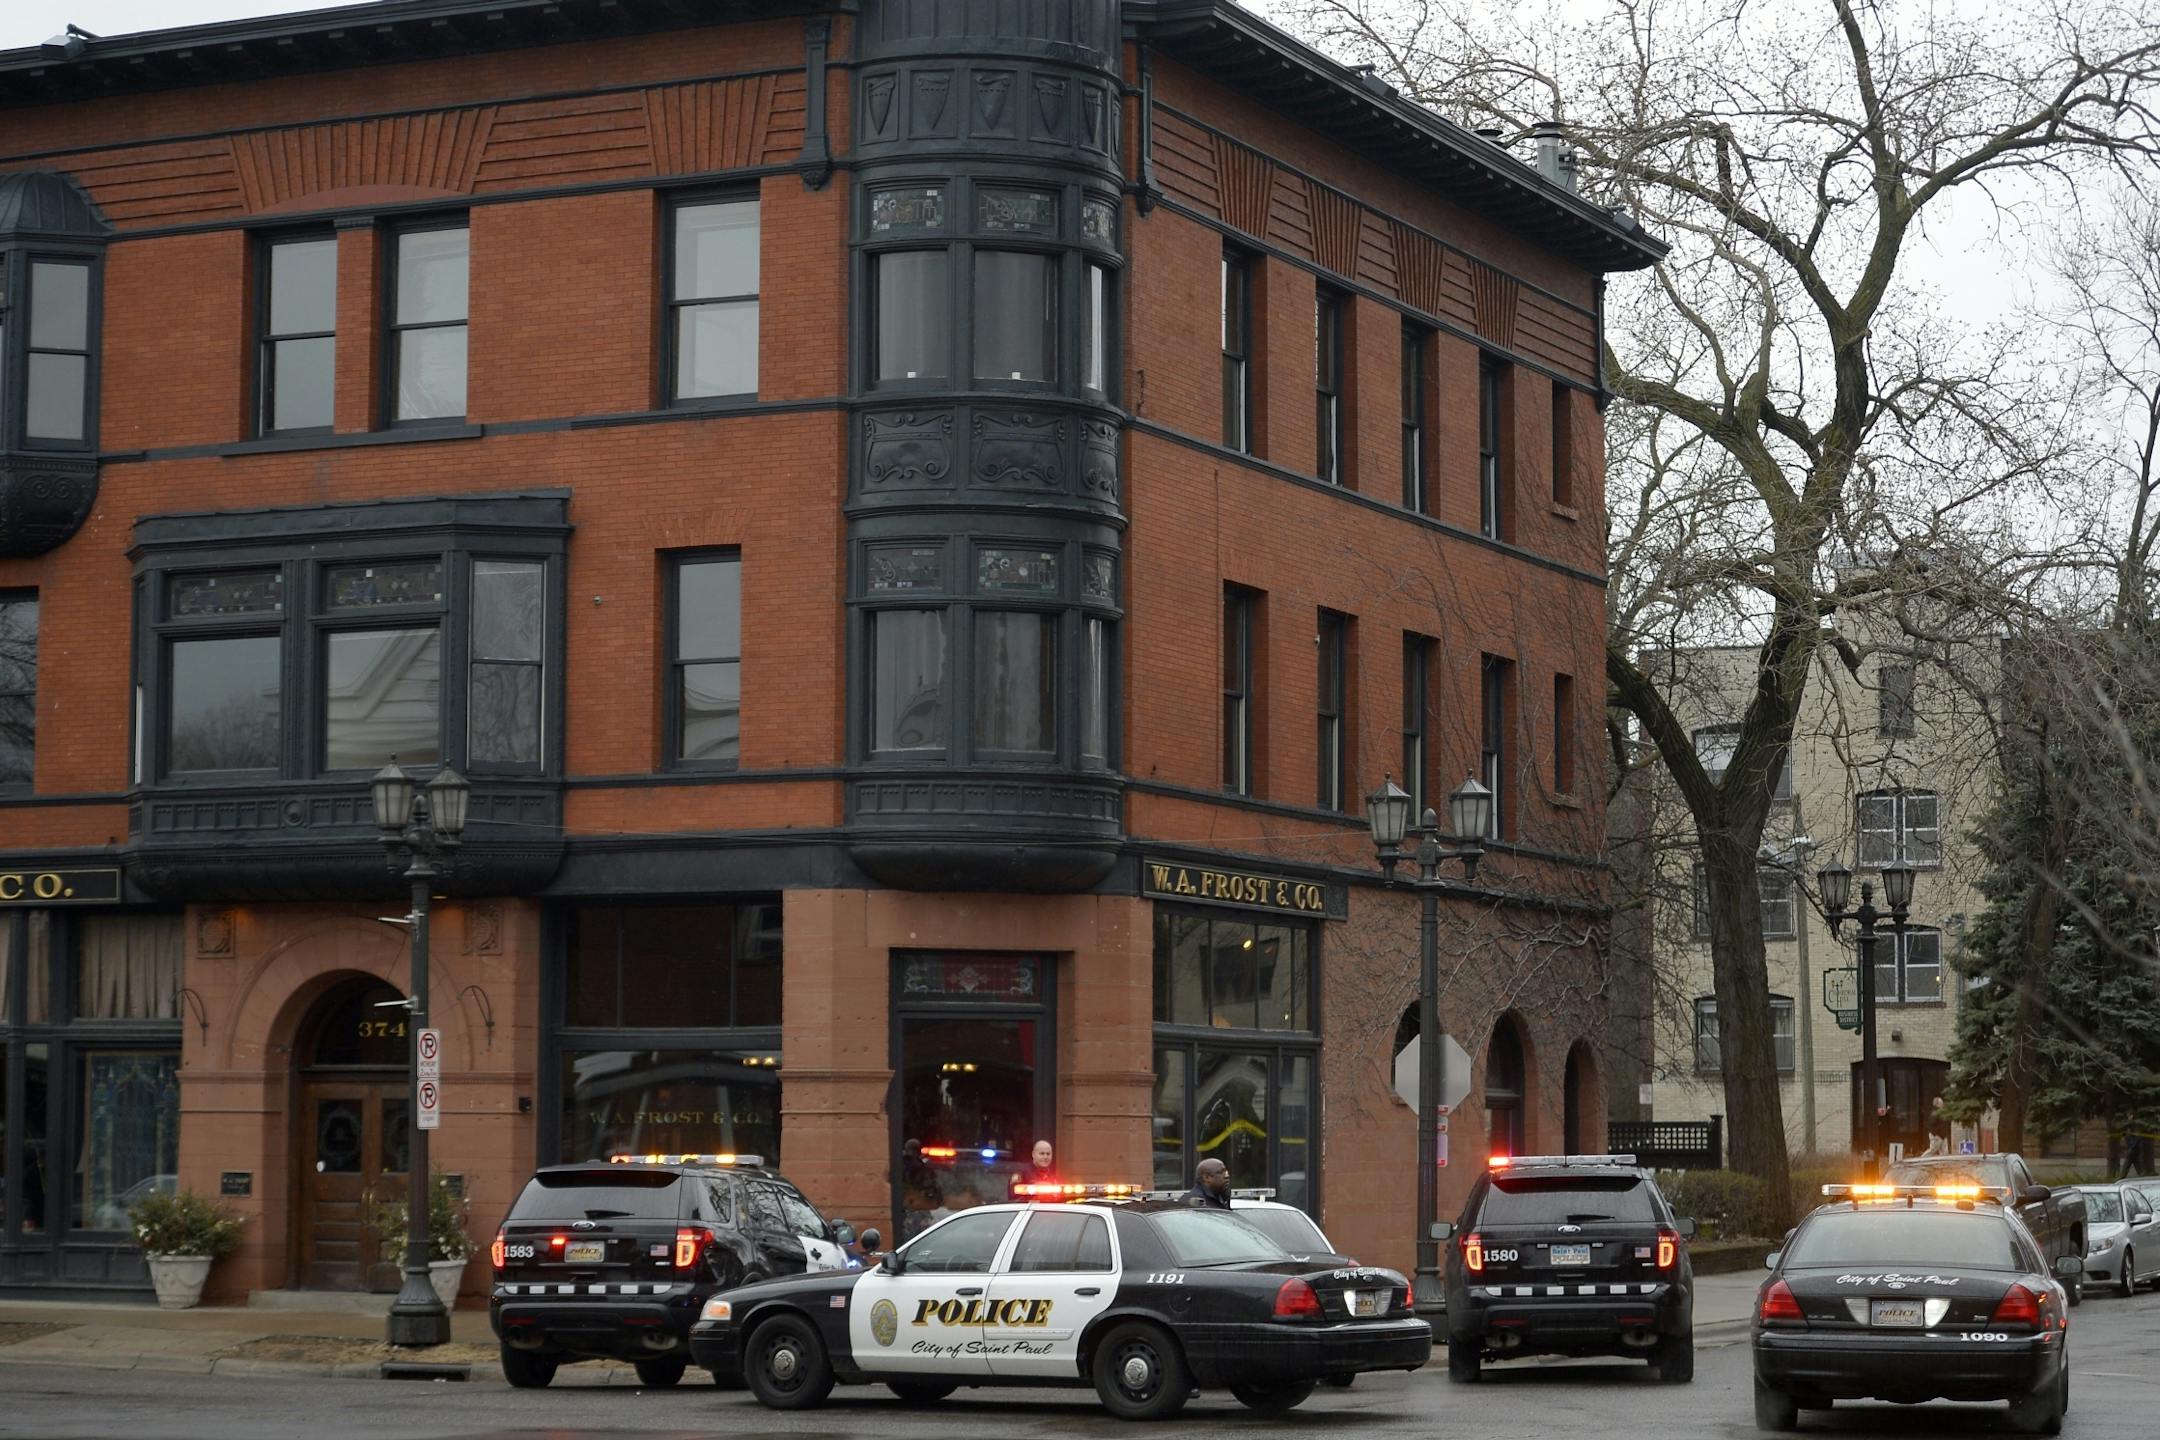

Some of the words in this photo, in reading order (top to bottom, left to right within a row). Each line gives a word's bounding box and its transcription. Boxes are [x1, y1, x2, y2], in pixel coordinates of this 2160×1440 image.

[0, 873, 74, 899] CO.
[1151, 864, 1172, 891] W.
[1175, 869, 1196, 894] A.
[1200, 871, 1270, 904] FROST
[1276, 881, 1289, 906] &
[1294, 883, 1323, 910] CO.
[358, 1022, 407, 1038] 374
[633, 1111, 704, 1125] FROST
[504, 1245, 534, 1258] 1583
[1483, 1249, 1518, 1262] 1580
[1146, 1273, 1185, 1284] 1191
[1333, 1270, 1350, 1280] City
[1350, 1270, 1358, 1280] of
[1836, 1274, 1866, 1286] City
[1866, 1274, 1882, 1286] of
[1883, 1273, 1922, 1283] Saint
[1923, 1275, 1960, 1286] Paul
[911, 1299, 1053, 1328] POLICE
[1960, 1332, 2008, 1341] 1090
[911, 1341, 944, 1358] City
[946, 1343, 963, 1358] of
[965, 1341, 1009, 1354] Saint
[1013, 1341, 1054, 1354] Paul
